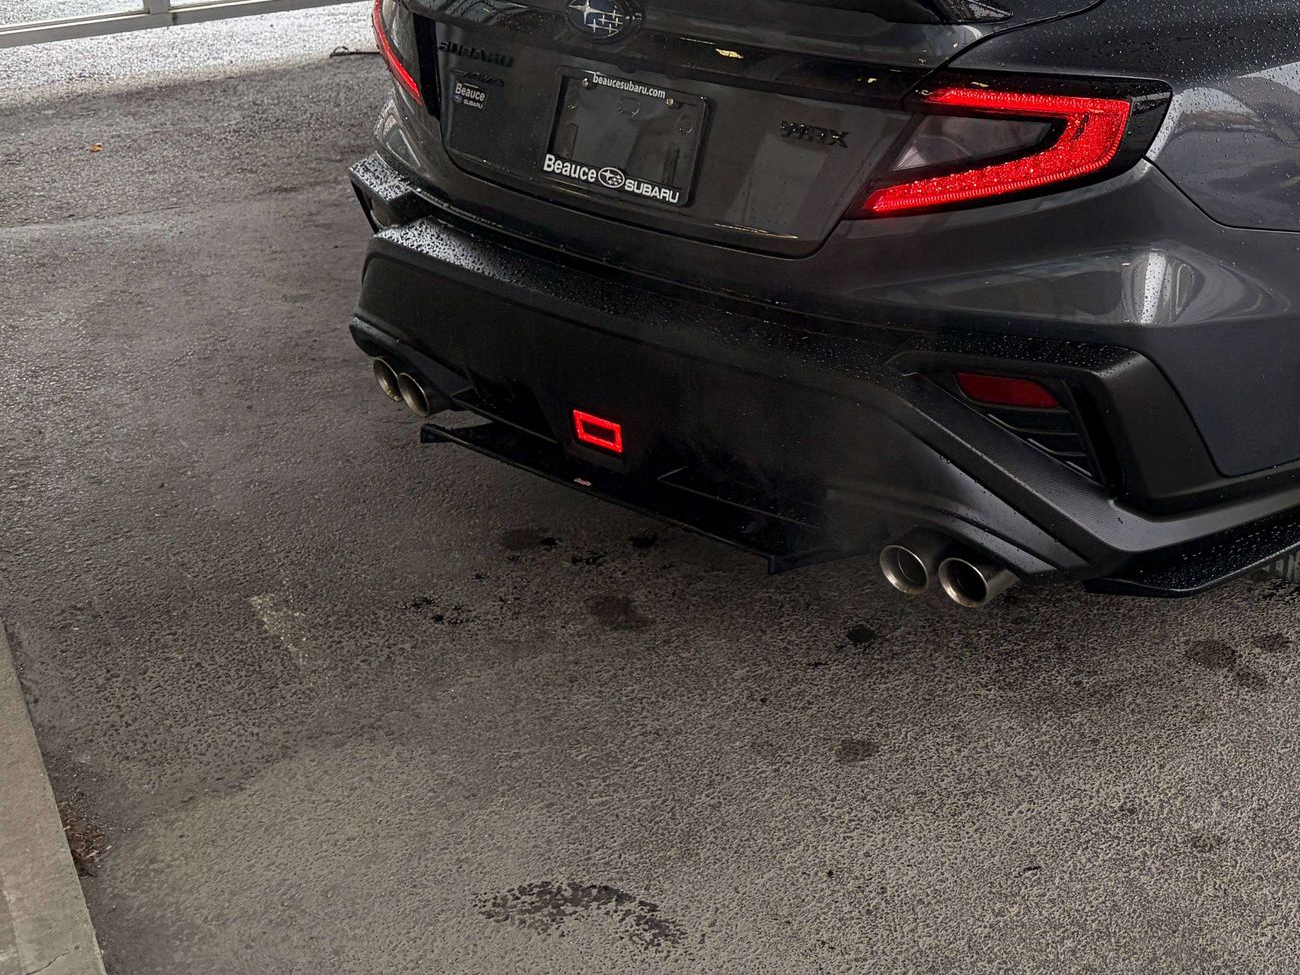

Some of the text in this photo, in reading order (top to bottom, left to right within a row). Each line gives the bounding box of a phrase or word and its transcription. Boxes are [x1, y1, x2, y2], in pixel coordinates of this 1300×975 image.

[455, 83, 485, 101] Beauce
[592, 73, 666, 99] beaucesubaru.com
[463, 99, 483, 109] SUBARU
[781, 121, 849, 148] WRX
[543, 153, 680, 203] Beauce SUBARU
